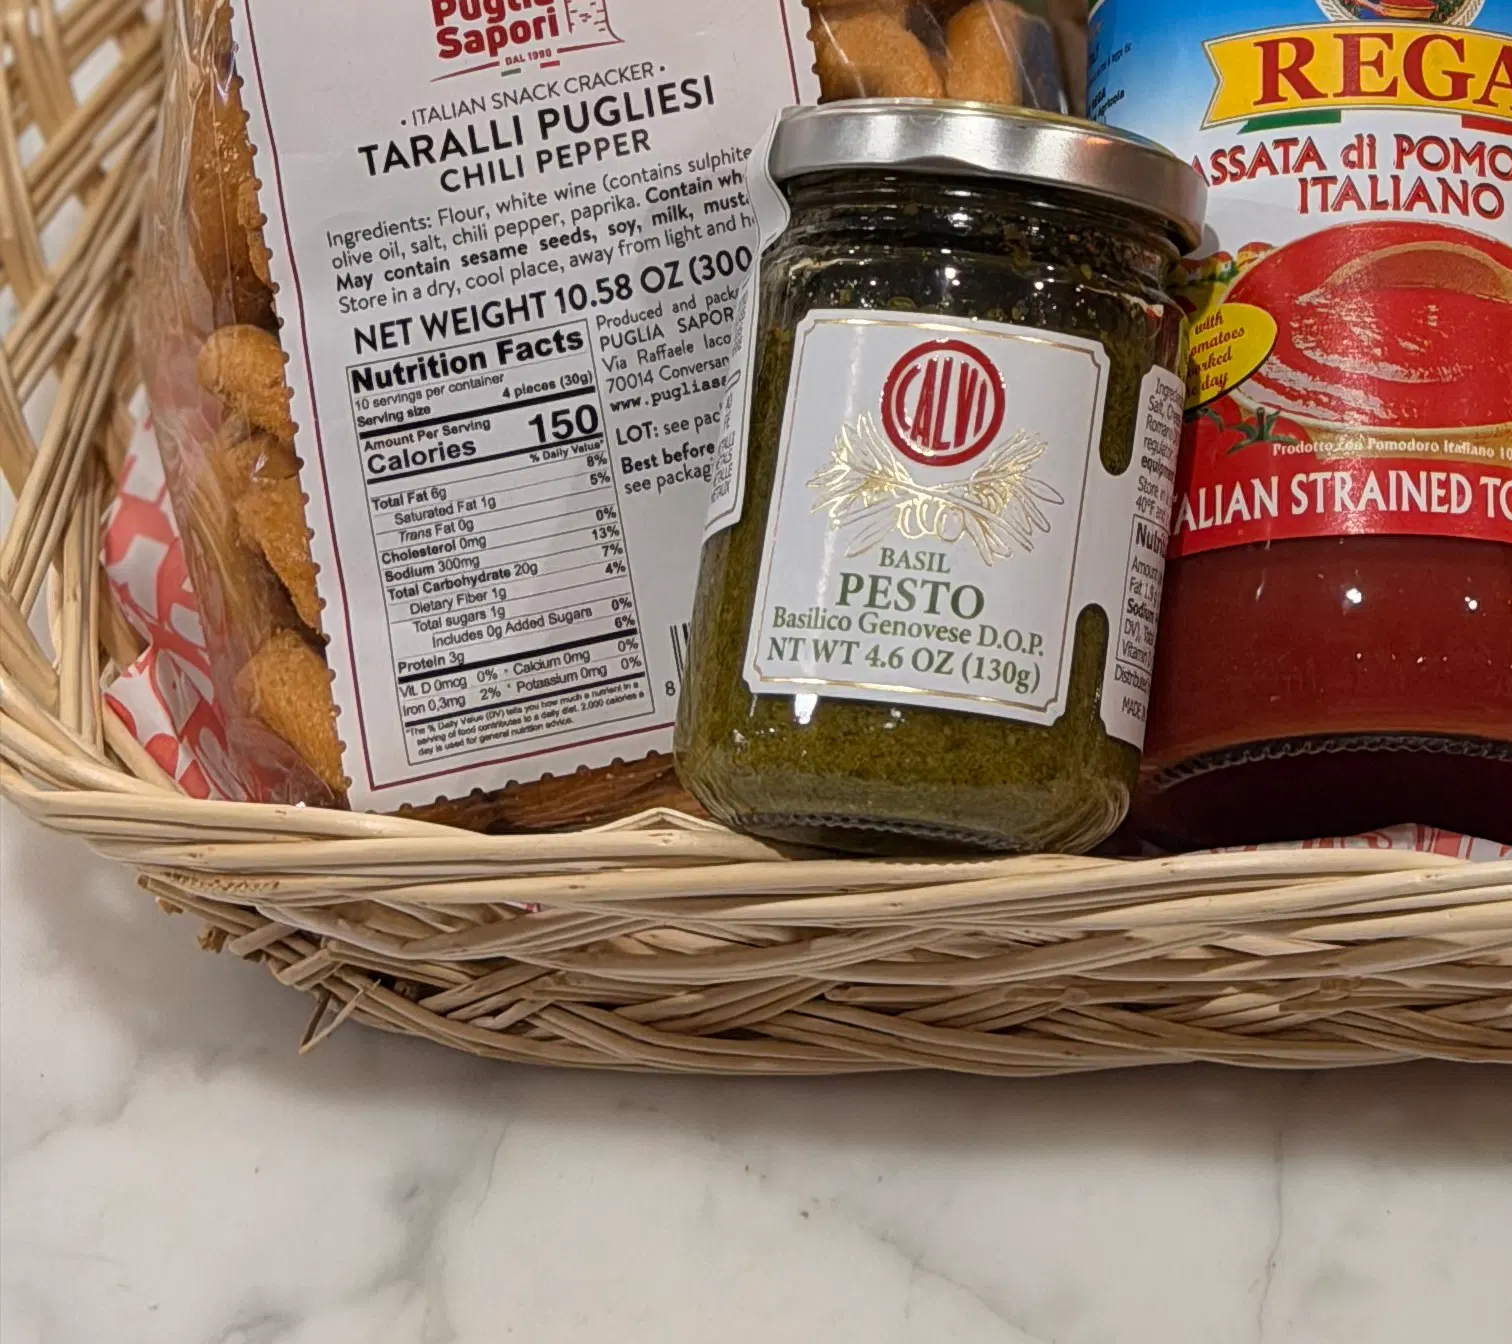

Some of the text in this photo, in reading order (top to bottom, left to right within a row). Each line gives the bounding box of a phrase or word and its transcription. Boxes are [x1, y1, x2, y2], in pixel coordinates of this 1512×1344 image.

[437, 9, 560, 60] Sapori
[505, 54, 526, 66] DAL
[411, 61, 654, 126] ITALIAN SNACK CRACKER
[357, 74, 714, 176] TARALLI PUGLIESI
[440, 128, 650, 192] CHILI PEPPER
[1191, 135, 1327, 187] ASSATA
[1340, 133, 1377, 170] di
[326, 146, 752, 249] Ingredients: Flour, white wine (contains sulphite
[332, 179, 712, 269] olive oil, salt, chili pepper, paprika. Contain
[1298, 175, 1505, 220] ITALIANO
[336, 272, 373, 291] May
[384, 256, 450, 281] contain
[460, 243, 527, 267] sesame
[539, 226, 597, 251] seeds,
[607, 219, 642, 236] soy,
[651, 204, 693, 226] milk,
[354, 245, 752, 354] NET WEIGHT 10.58 OZ (300
[599, 306, 733, 351] PUGLIA SAPOR
[1190, 327, 1245, 358] omatoes
[351, 330, 583, 393] Nutrition Facts
[1201, 372, 1229, 393] day
[355, 373, 504, 411] 10 servings per container
[356, 411, 404, 427] Serving
[406, 405, 431, 417] size
[559, 370, 592, 389] (30g)
[895, 356, 988, 452] CALVI
[364, 419, 490, 452] Amount Per Serving
[367, 404, 602, 474] Calories 150
[542, 447, 568, 460] Daily
[615, 420, 658, 445] LOT:
[620, 441, 714, 474] Best before
[1272, 440, 1334, 457] Prodotto
[1366, 436, 1441, 455] Pomodoro
[1443, 439, 1495, 459] Italiano
[371, 452, 607, 510] Total Fat 6g 8%
[1173, 475, 1280, 536] ALIAN
[1290, 469, 1472, 514] STRAINED
[877, 547, 951, 576] BASIL
[835, 572, 985, 620] PESTO
[772, 606, 1045, 658] Basilico Genovese D.O.P.
[766, 637, 1041, 696] NT WT 4.6 OZ (130g)
